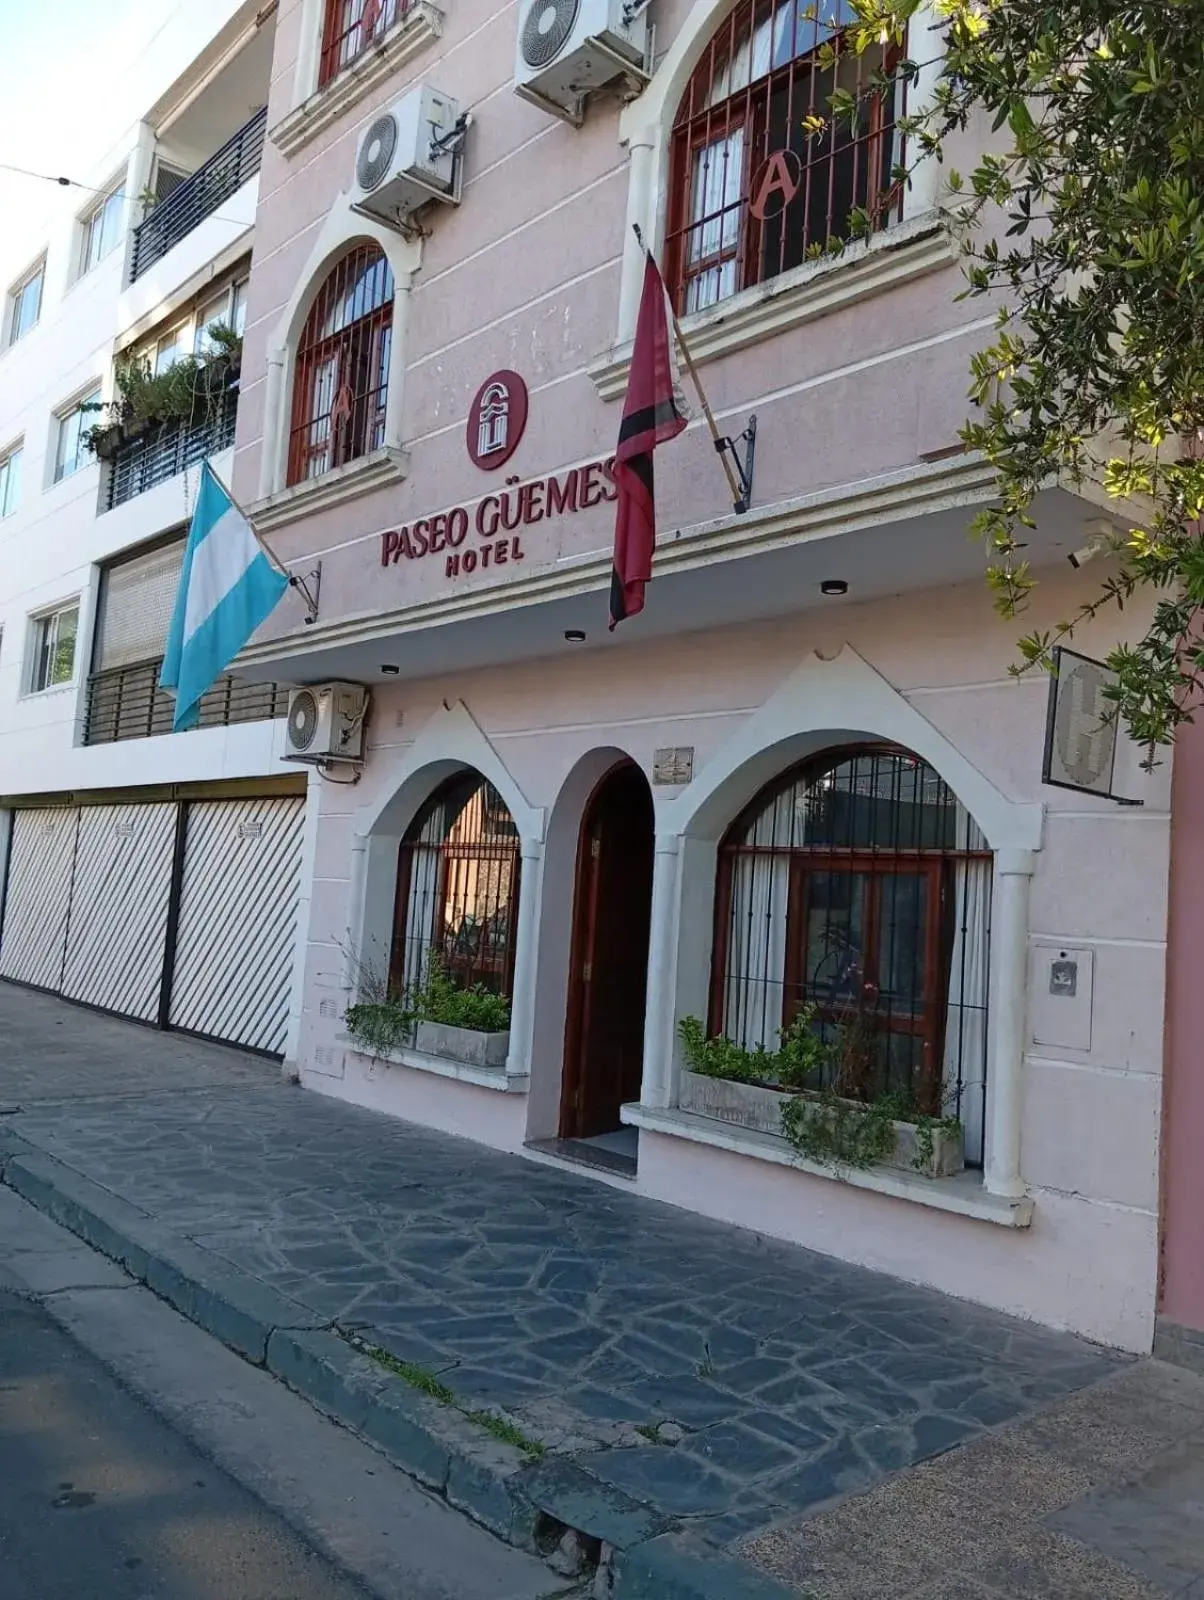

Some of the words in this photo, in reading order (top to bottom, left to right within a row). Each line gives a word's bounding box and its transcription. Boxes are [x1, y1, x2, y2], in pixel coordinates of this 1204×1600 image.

[381, 507, 469, 567] PASEO
[475, 456, 618, 537] GÜEMES
[445, 537, 524, 577] HOTEL
